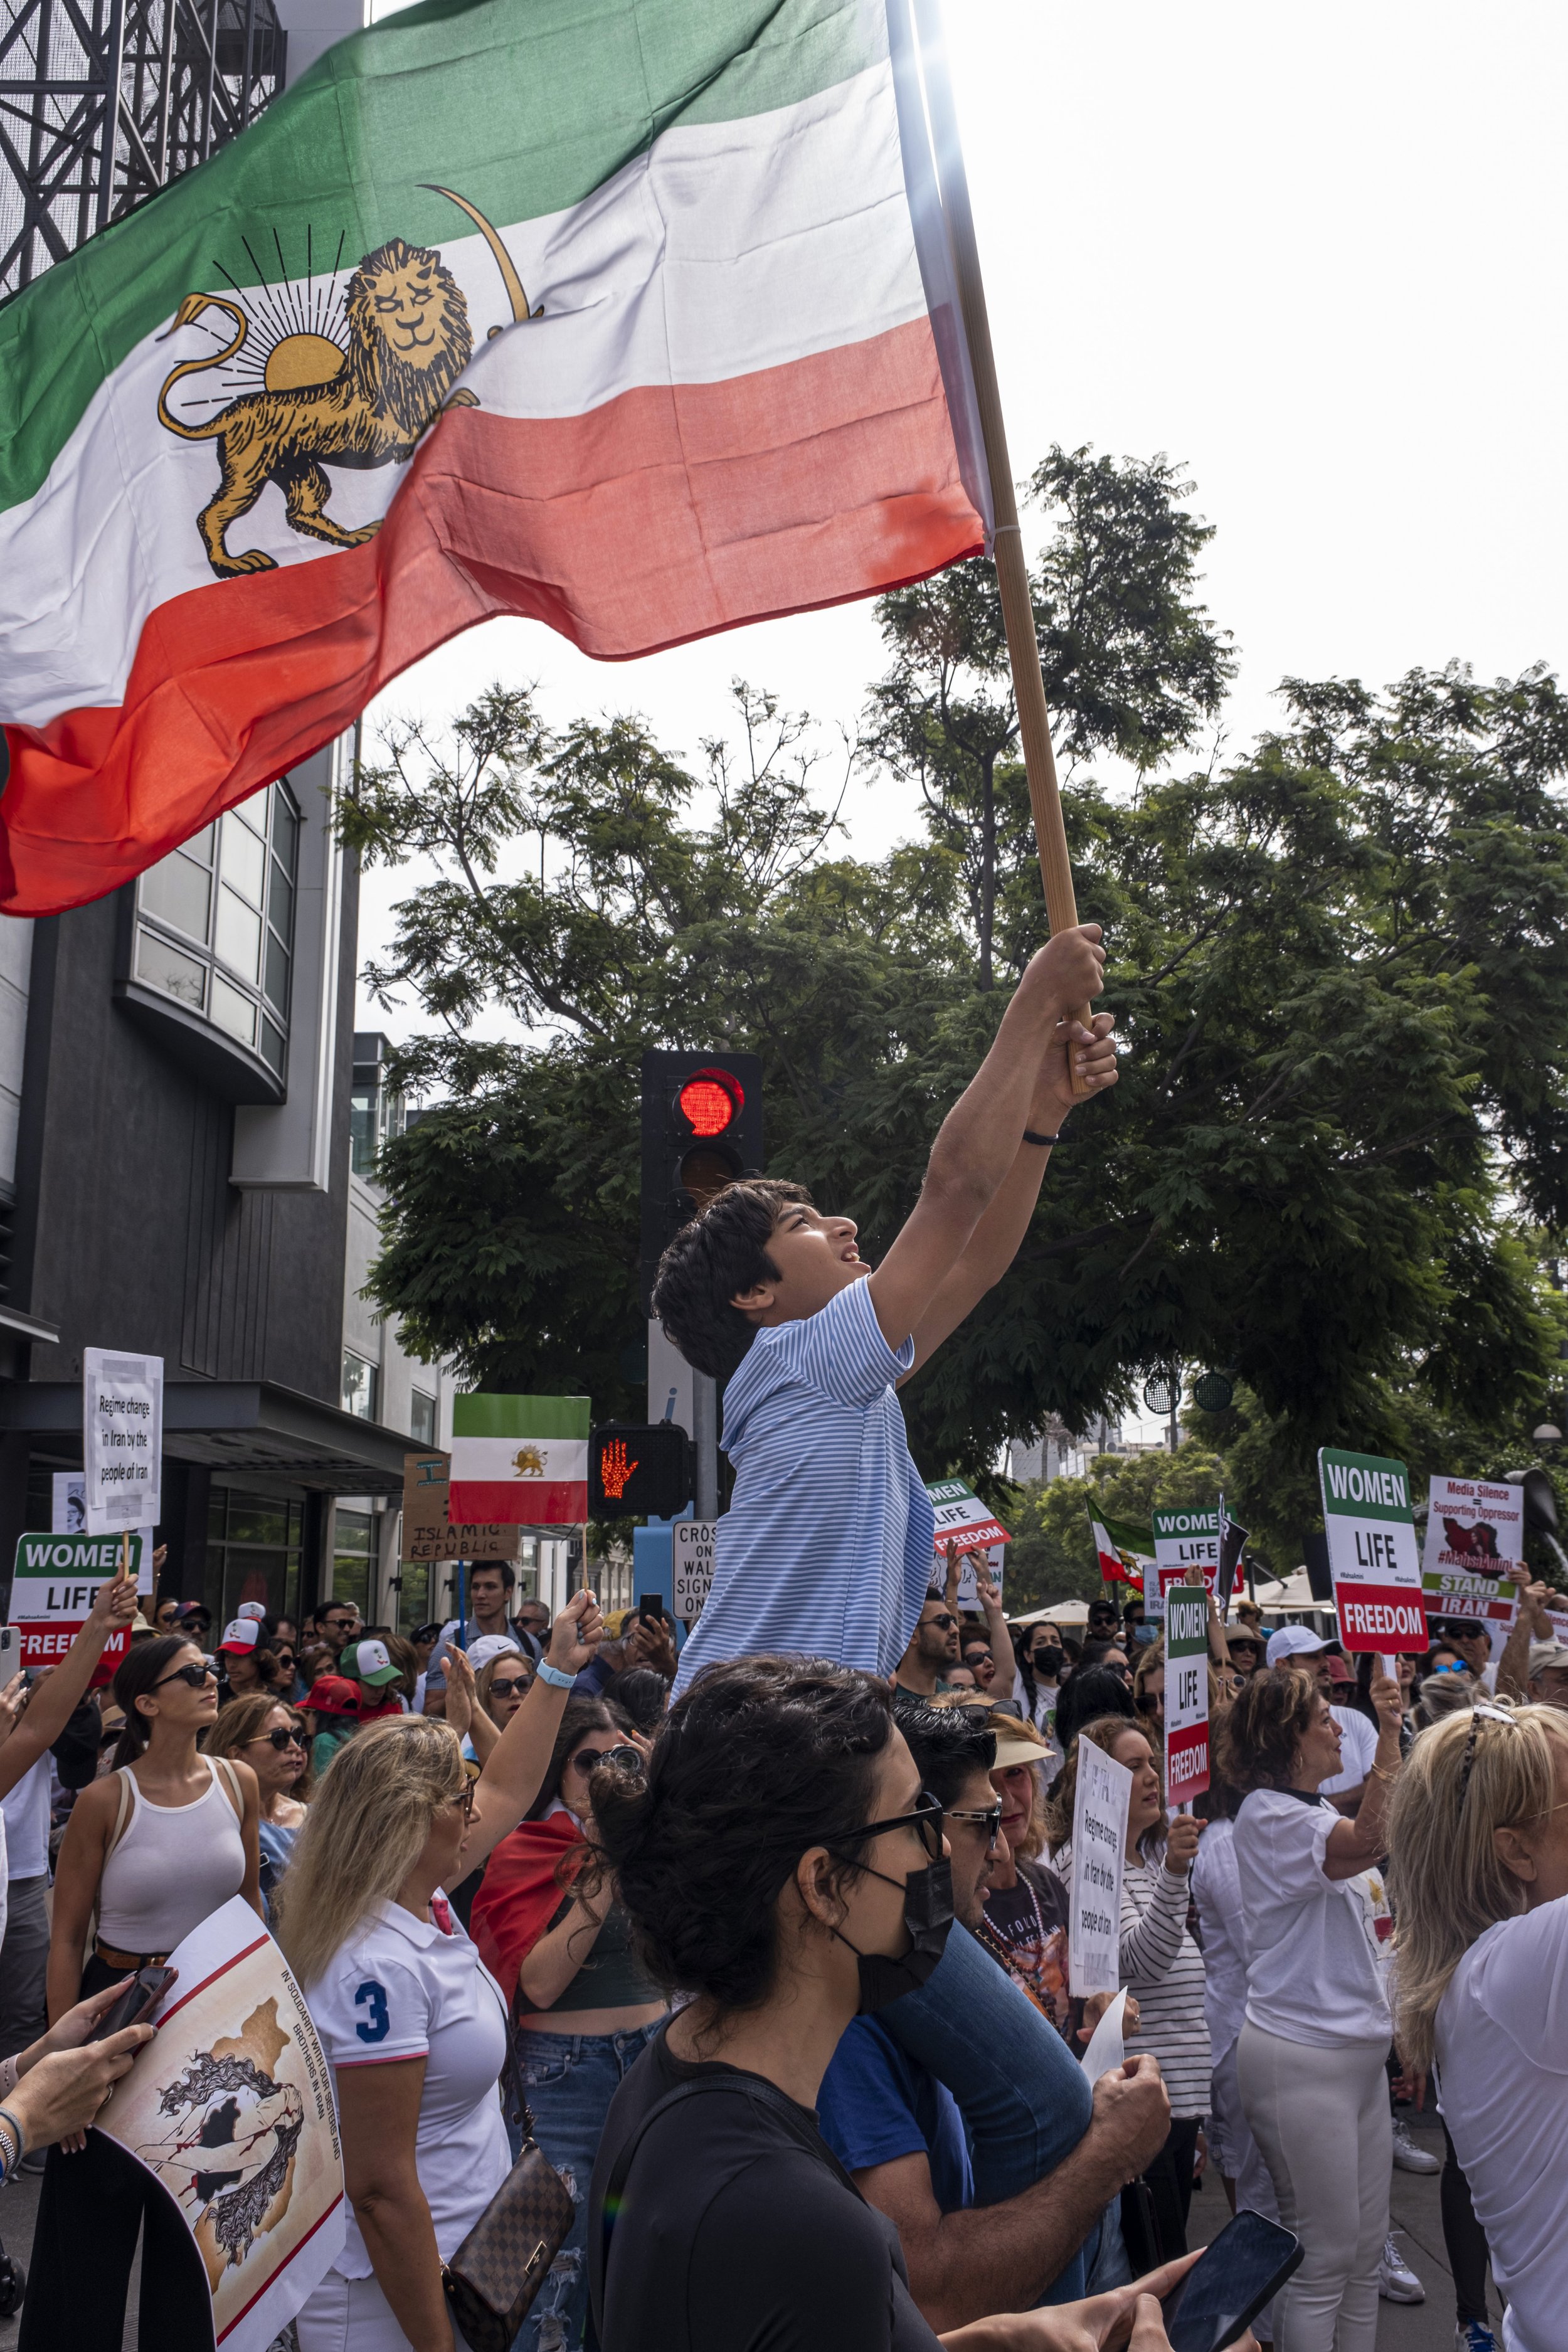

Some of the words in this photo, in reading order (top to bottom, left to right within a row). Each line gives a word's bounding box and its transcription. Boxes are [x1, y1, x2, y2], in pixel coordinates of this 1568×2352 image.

[99, 1395, 125, 1417] Regime
[126, 1397, 150, 1419] change
[102, 1428, 109, 1446] in
[110, 1429, 126, 1446] Iran
[127, 1429, 135, 1451] by
[136, 1429, 147, 1447] the
[101, 1462, 125, 1486] people
[126, 1462, 135, 1480] of
[135, 1463, 148, 1480] Iran
[1327, 1463, 1407, 1508] WOMEN
[926, 1482, 968, 1502] MEN
[1447, 1481, 1475, 1496] Media
[1477, 1484, 1510, 1500] Silence
[935, 1507, 970, 1525] LIFE
[1433, 1501, 1476, 1519] Supporting
[1478, 1506, 1519, 1522] Oppressor
[680, 1527, 716, 1543] CROS
[26, 1544, 135, 1567] WOMEN
[696, 1545, 712, 1558] ON
[1179, 1542, 1218, 1560] LIFE
[1355, 1531, 1397, 1569] LIFE
[1438, 1550, 1513, 1571] #MahsaAmini
[684, 1560, 714, 1576] WAL
[677, 1579, 712, 1594] SIGN
[1439, 1575, 1500, 1596] STAND
[1441, 1597, 1490, 1616] IRAN
[1170, 1602, 1205, 1641] WOMEN
[1343, 1603, 1423, 1634] FREEDOM
[20, 1633, 124, 1655] FREEM
[1179, 1669, 1198, 1710] LIFE
[1170, 1742, 1207, 1787] FREEDOM
[1085, 1809, 1103, 1841] Regime
[1104, 1820, 1117, 1853] change
[1084, 1856, 1089, 1881] in
[1090, 1859, 1099, 1885] Iran
[1100, 1863, 1107, 1893] by
[1106, 1867, 1114, 1892] the
[1081, 1906, 1098, 1936] people
[1098, 1909, 1103, 1933] of
[1103, 1911, 1111, 1936] Iran
[354, 1979, 390, 2043] 3
[293, 2023, 317, 2079] BROTHERS
[281, 1969, 292, 1983] IN
[287, 1983, 315, 2037] SOLIDARITY
[311, 2037, 324, 2067] WITH
[320, 2067, 330, 2091] OUR
[325, 2091, 337, 2136] SISTERS
[332, 2137, 341, 2161] AND
[312, 2078, 320, 2092] IN
[315, 2093, 326, 2120] IRAN
